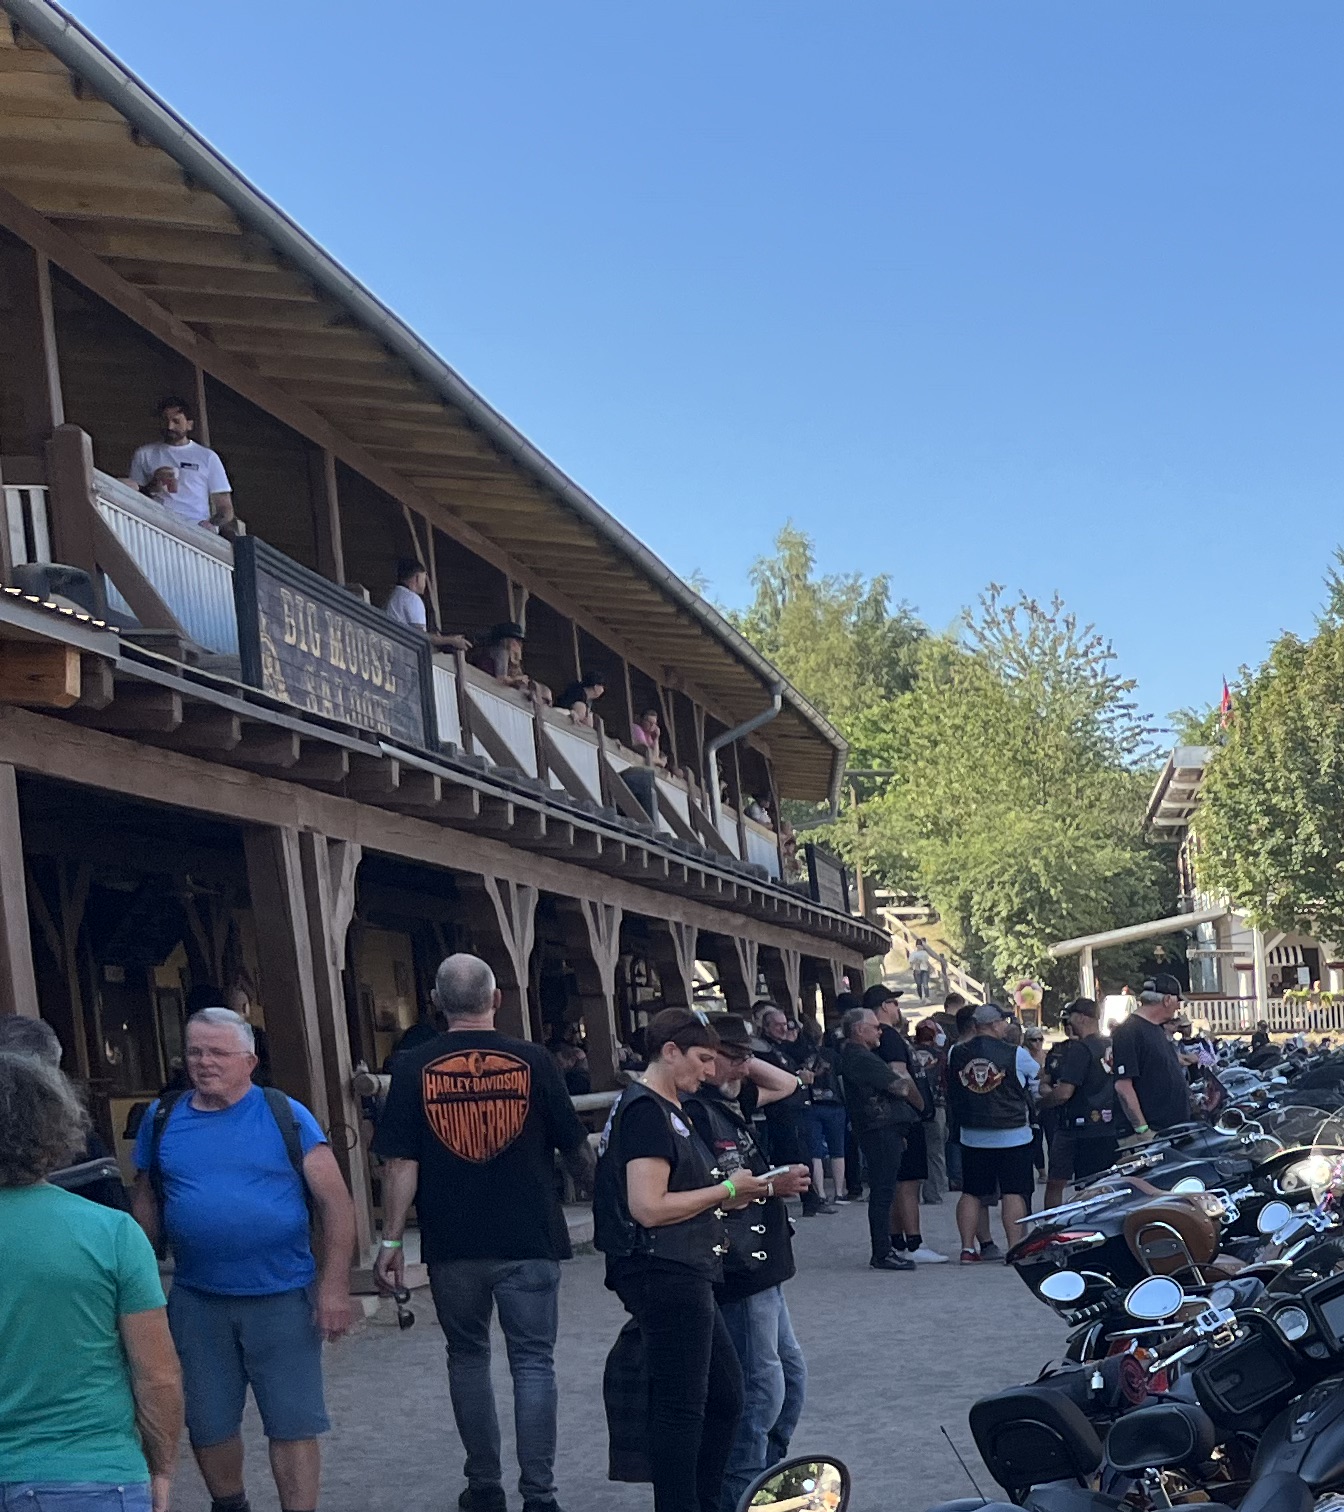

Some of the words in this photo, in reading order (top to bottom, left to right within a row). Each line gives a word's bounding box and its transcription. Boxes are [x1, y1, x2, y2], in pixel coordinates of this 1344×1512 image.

[280, 587, 322, 659] BIG
[324, 610, 397, 694] MOOSE
[425, 1070, 528, 1101] HARLEY-DAVIDSON
[426, 1099, 528, 1161] THUNDERBIKE
